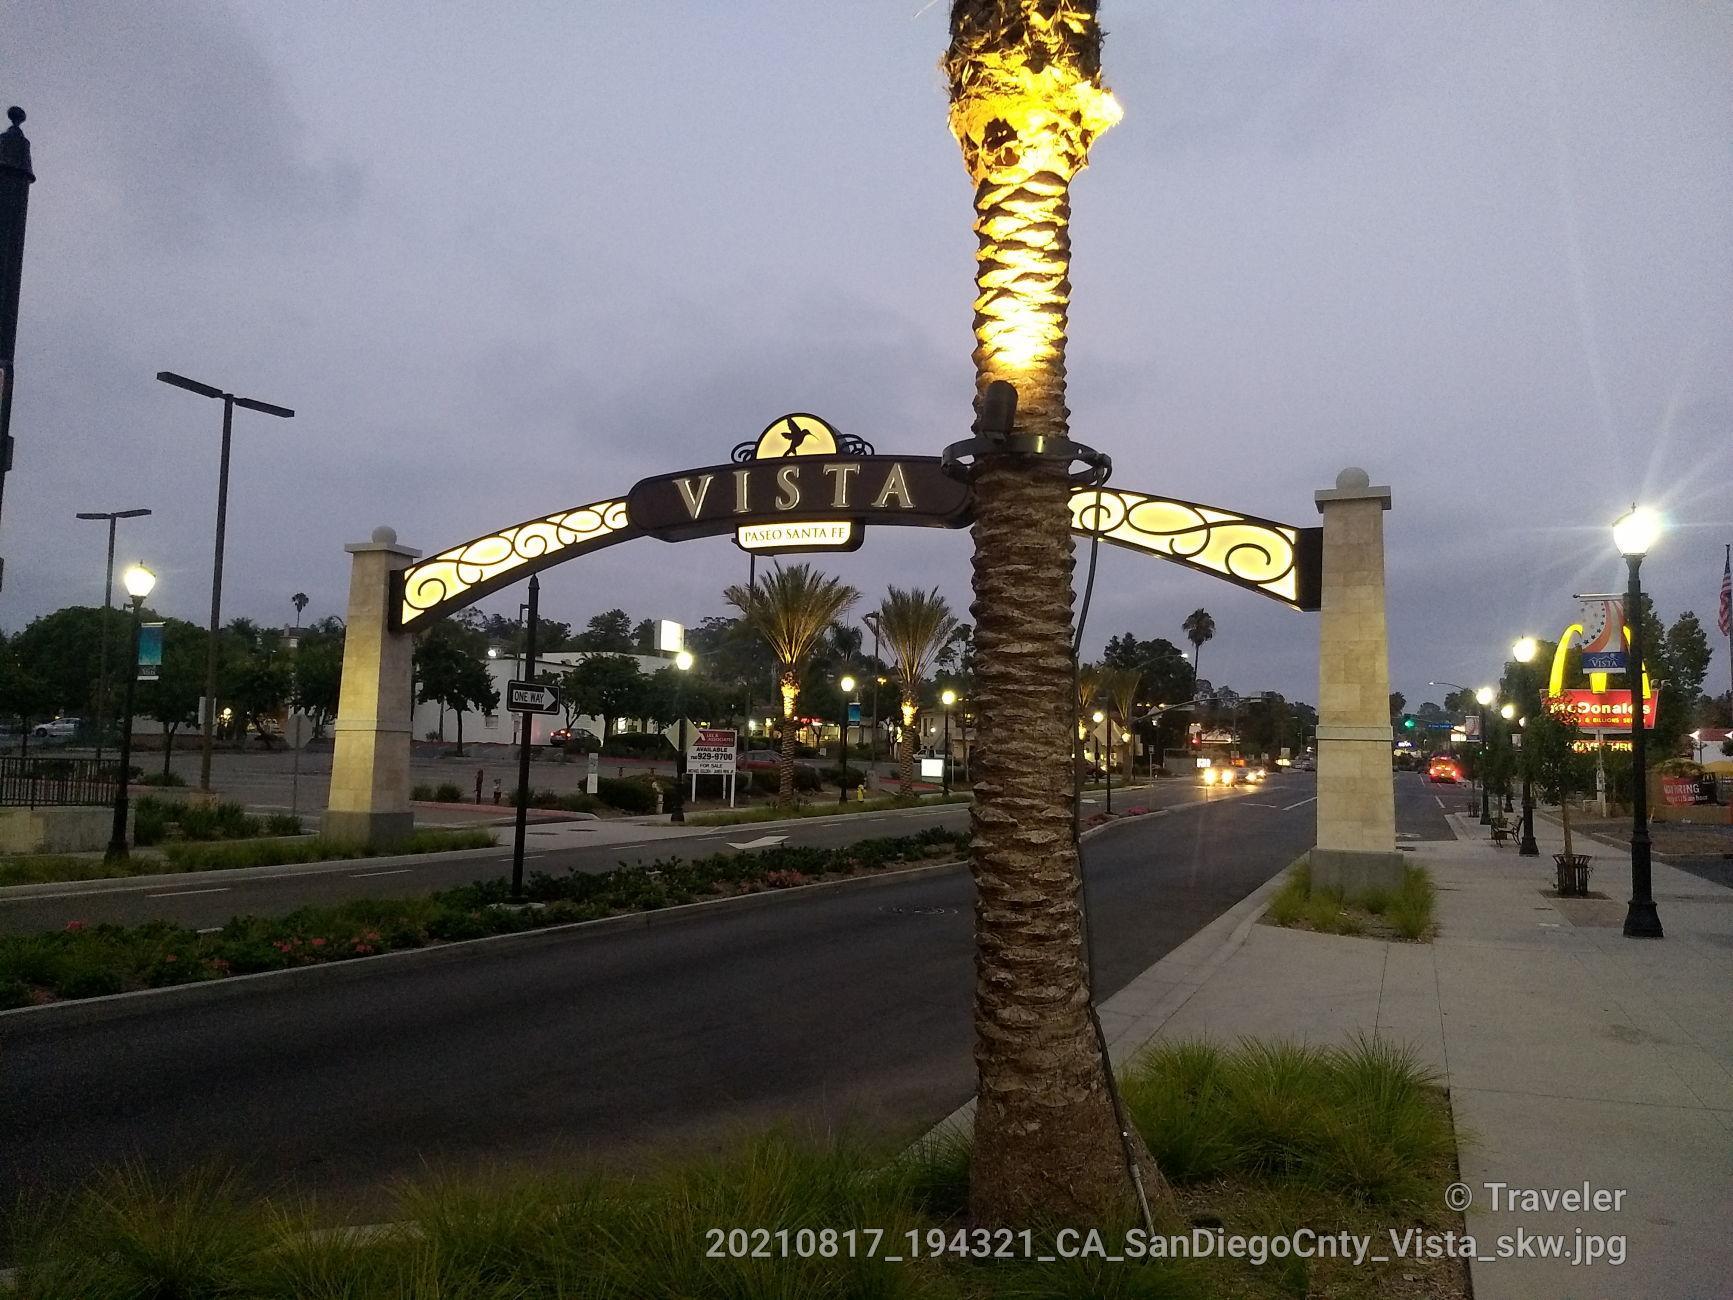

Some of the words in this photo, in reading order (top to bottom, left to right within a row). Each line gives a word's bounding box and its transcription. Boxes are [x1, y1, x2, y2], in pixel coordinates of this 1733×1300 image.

[673, 463, 916, 519] VISTA
[745, 529, 782, 542] PASEO
[786, 527, 827, 539] SANTA
[831, 527, 845, 538] FE
[1591, 659, 1618, 667] VISTA
[514, 691, 528, 702] ONE
[530, 692, 544, 703] WAY
[1549, 701, 1651, 714] McDonals
[698, 752, 733, 760] 929-9700
